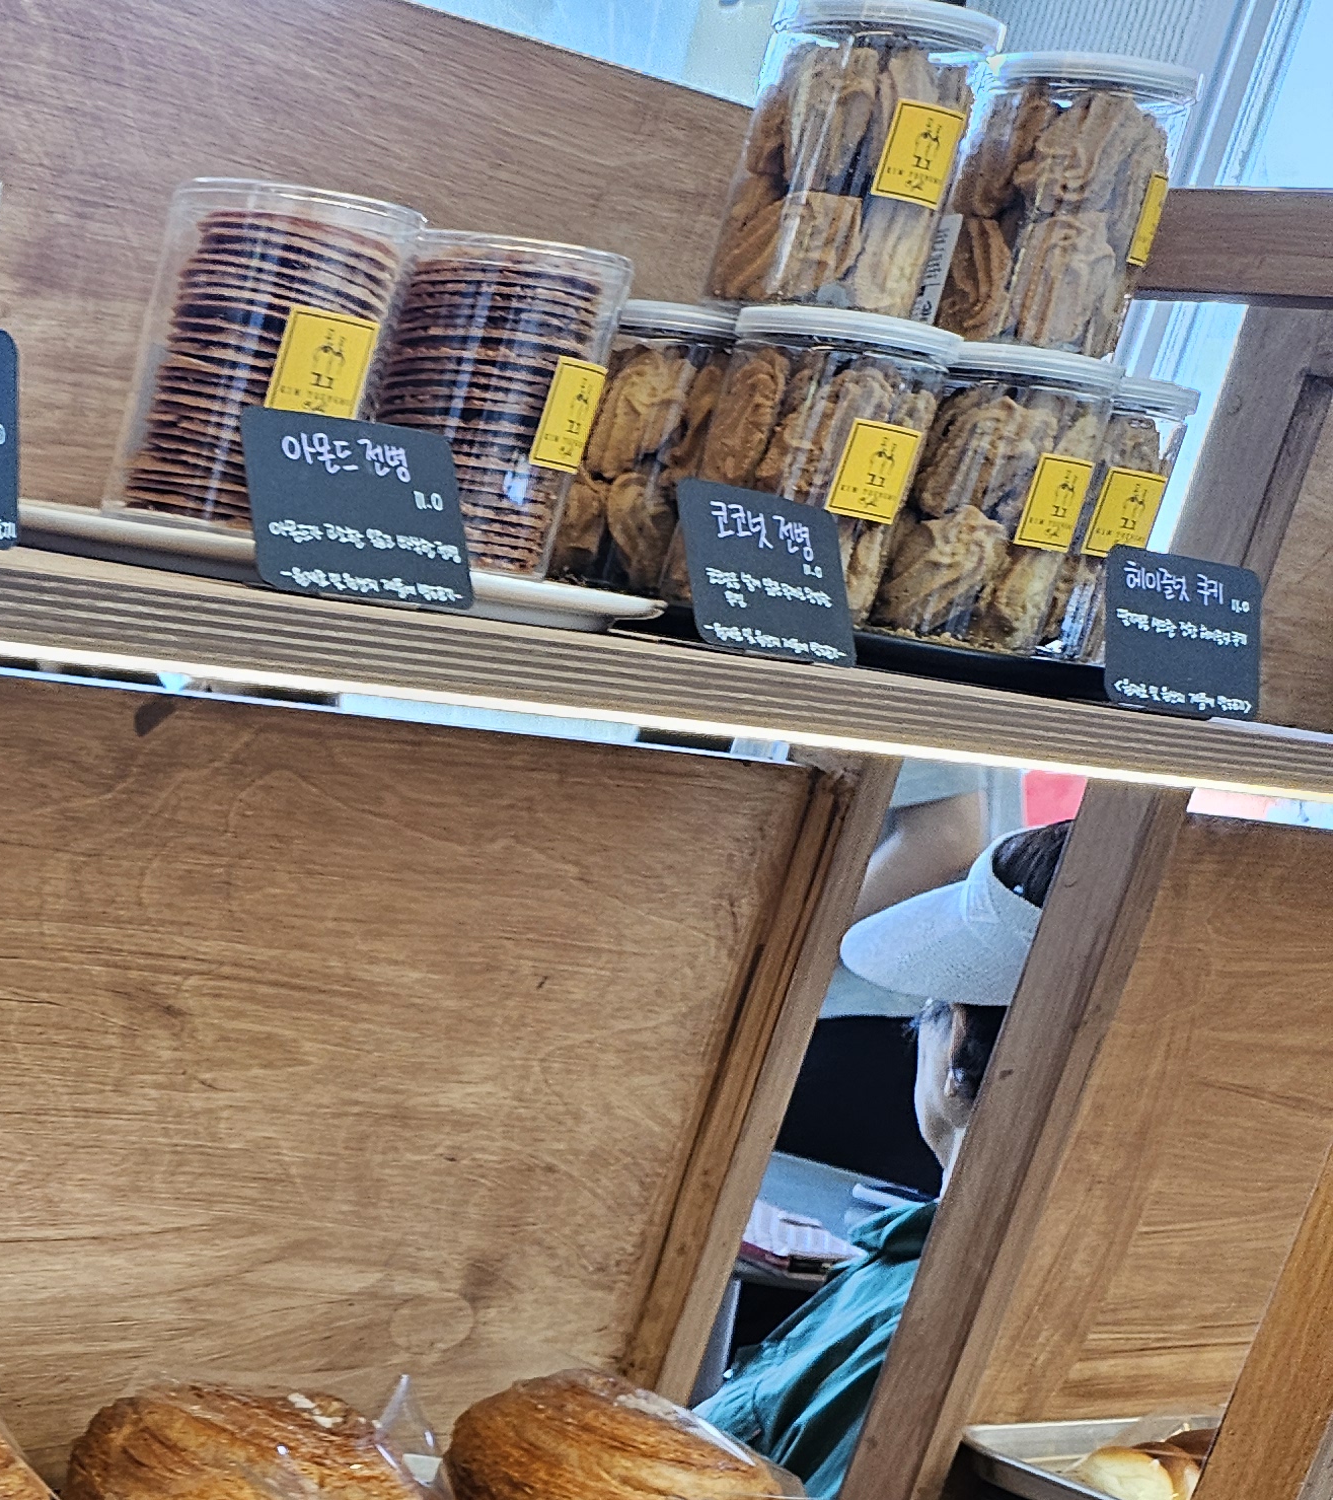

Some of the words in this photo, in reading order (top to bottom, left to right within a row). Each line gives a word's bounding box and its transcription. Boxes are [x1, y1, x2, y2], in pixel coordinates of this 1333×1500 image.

[282, 432, 359, 474] 아몬드
[357, 439, 411, 483] 전병
[709, 500, 774, 550] 코코넛
[772, 515, 814, 562] 전병
[1124, 560, 1190, 602] 헤이즐넛
[1196, 573, 1224, 606] 쿠키
